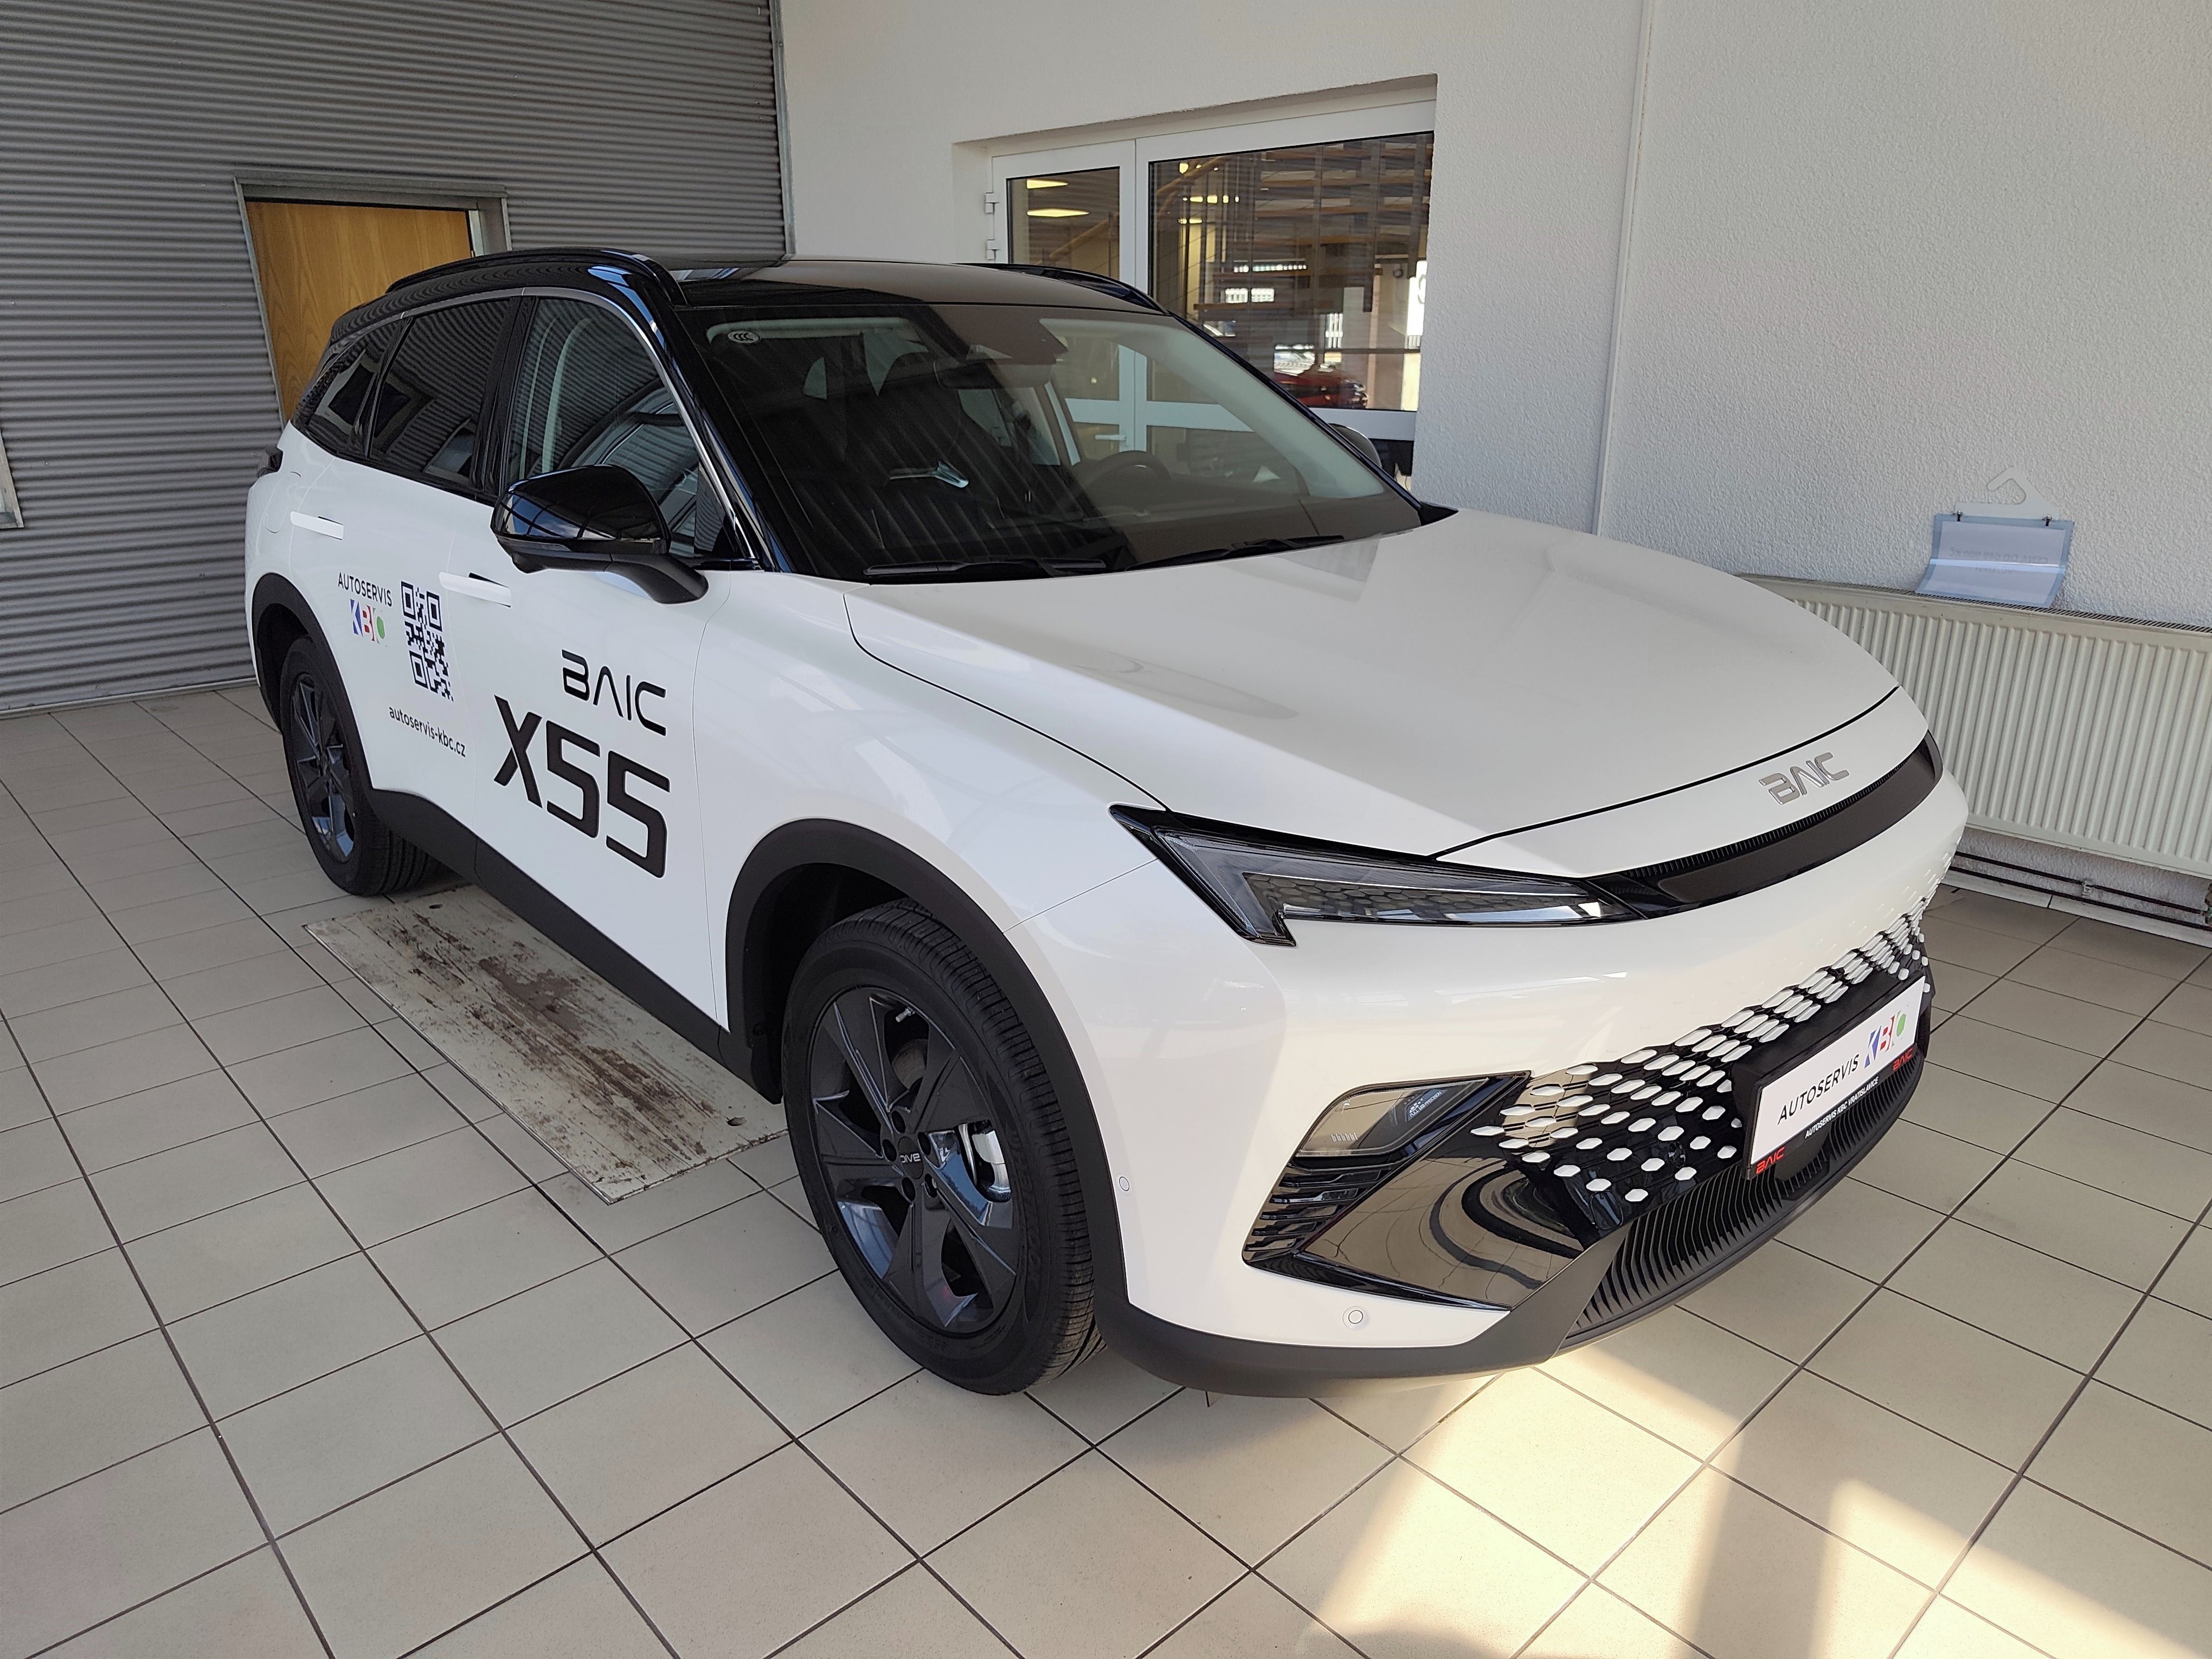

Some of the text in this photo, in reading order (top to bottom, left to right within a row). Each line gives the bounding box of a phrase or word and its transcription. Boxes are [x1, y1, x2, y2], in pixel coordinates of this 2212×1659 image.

[338, 571, 393, 607] AUTOSERVIS
[562, 649, 666, 736] BAIC
[389, 706, 466, 758] autoservis-kbc.cz
[493, 694, 670, 878] X55
[1758, 751, 1850, 805] BAIC
[1892, 1047, 1914, 1071] BAIC
[1777, 1053, 1860, 1126] AUTOSERVIS
[1804, 1076, 1879, 1139] AUTOSERVIS KBC VRATISLAVICE
[1755, 1146, 1786, 1175] BAIC
